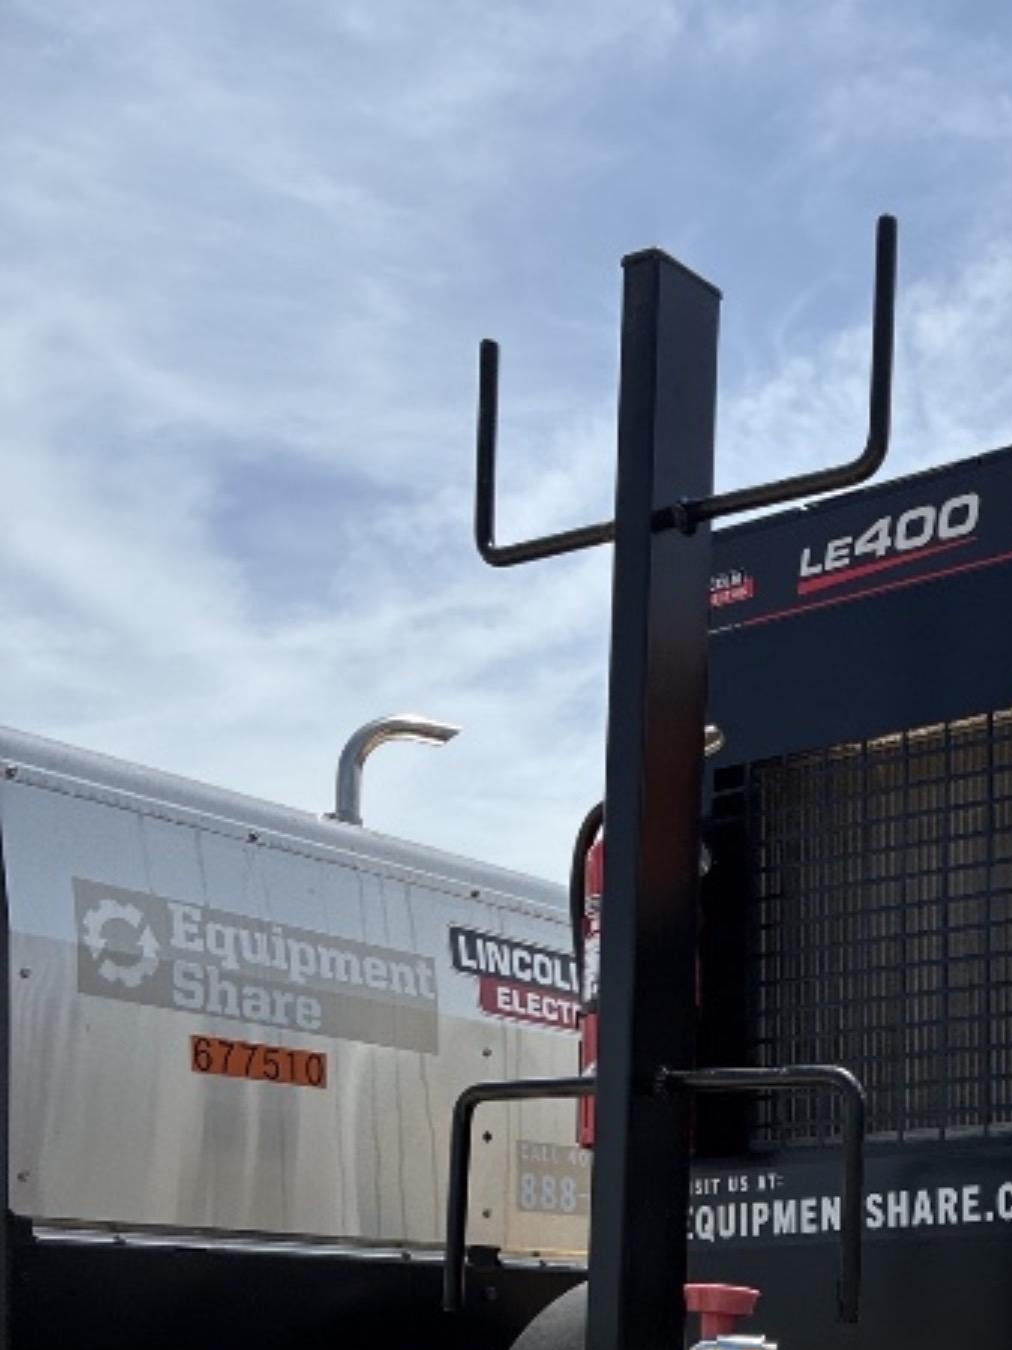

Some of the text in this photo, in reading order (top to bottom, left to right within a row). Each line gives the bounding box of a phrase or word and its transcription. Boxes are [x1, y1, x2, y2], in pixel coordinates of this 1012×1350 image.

[798, 493, 980, 577] LE400
[169, 902, 435, 999] Equipment
[172, 959, 322, 1031] Share
[192, 1036, 325, 1086] 677510
[727, 1175, 748, 1193] US
